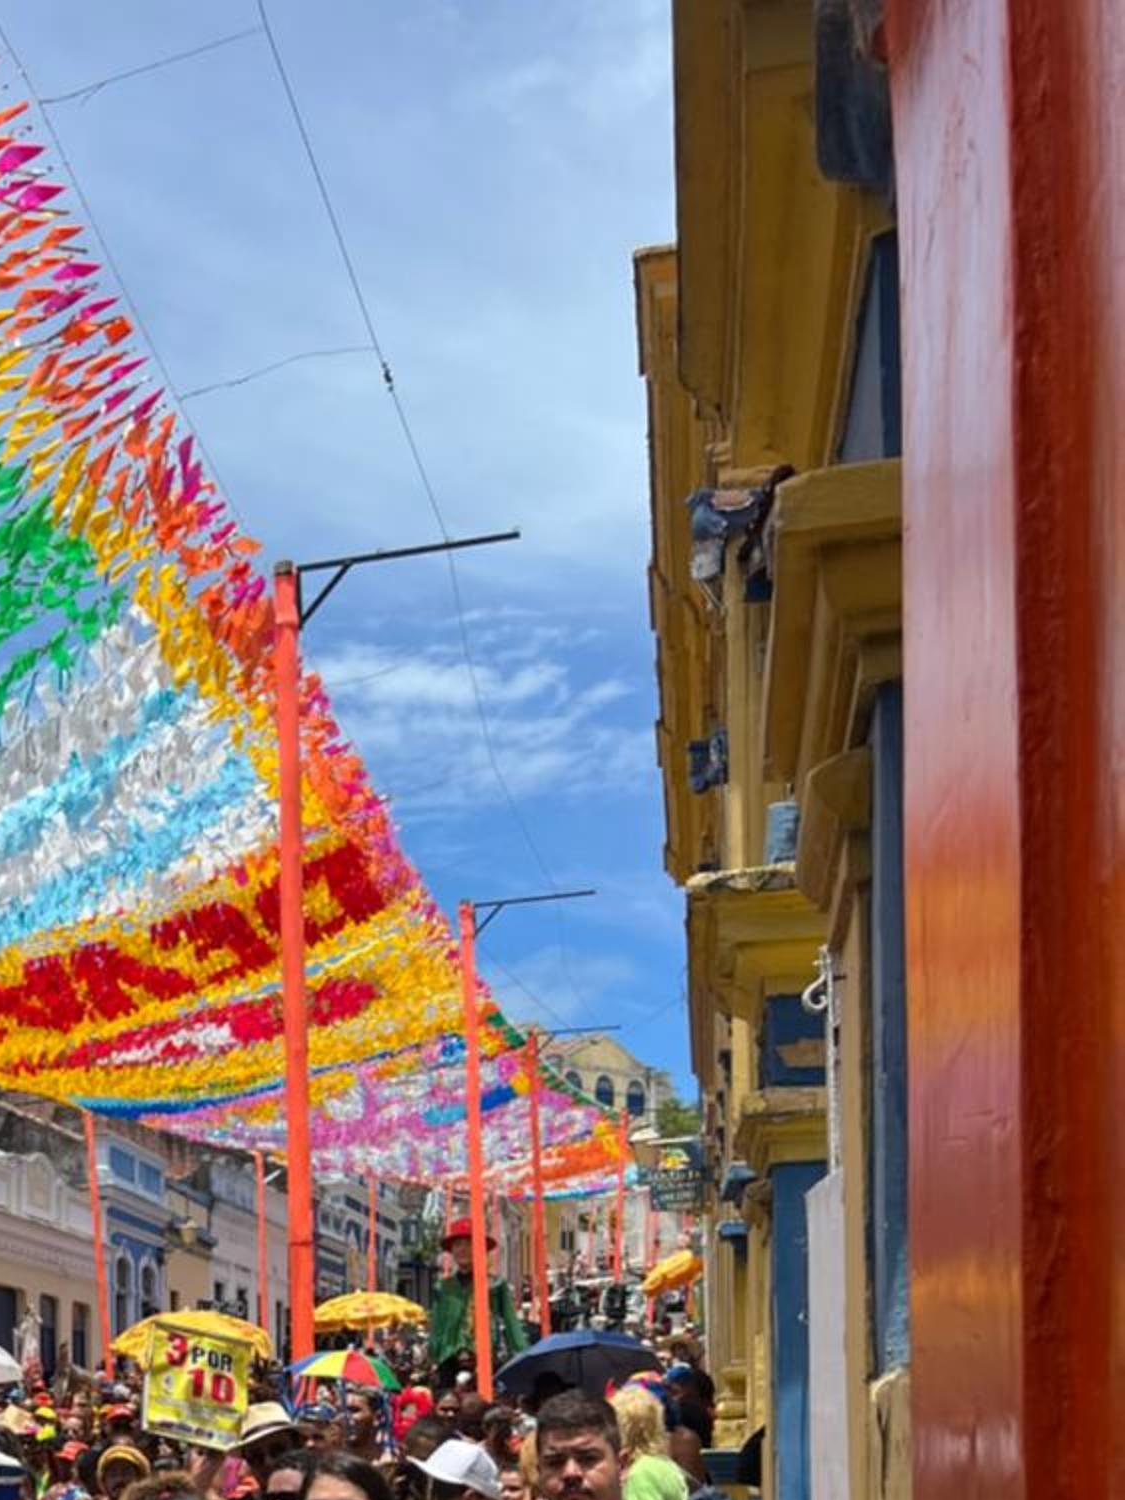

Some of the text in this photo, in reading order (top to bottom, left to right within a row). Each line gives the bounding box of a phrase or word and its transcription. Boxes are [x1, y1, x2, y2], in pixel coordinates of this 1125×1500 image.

[166, 1333, 233, 1372] 3 POR
[189, 1368, 235, 1404] 10
